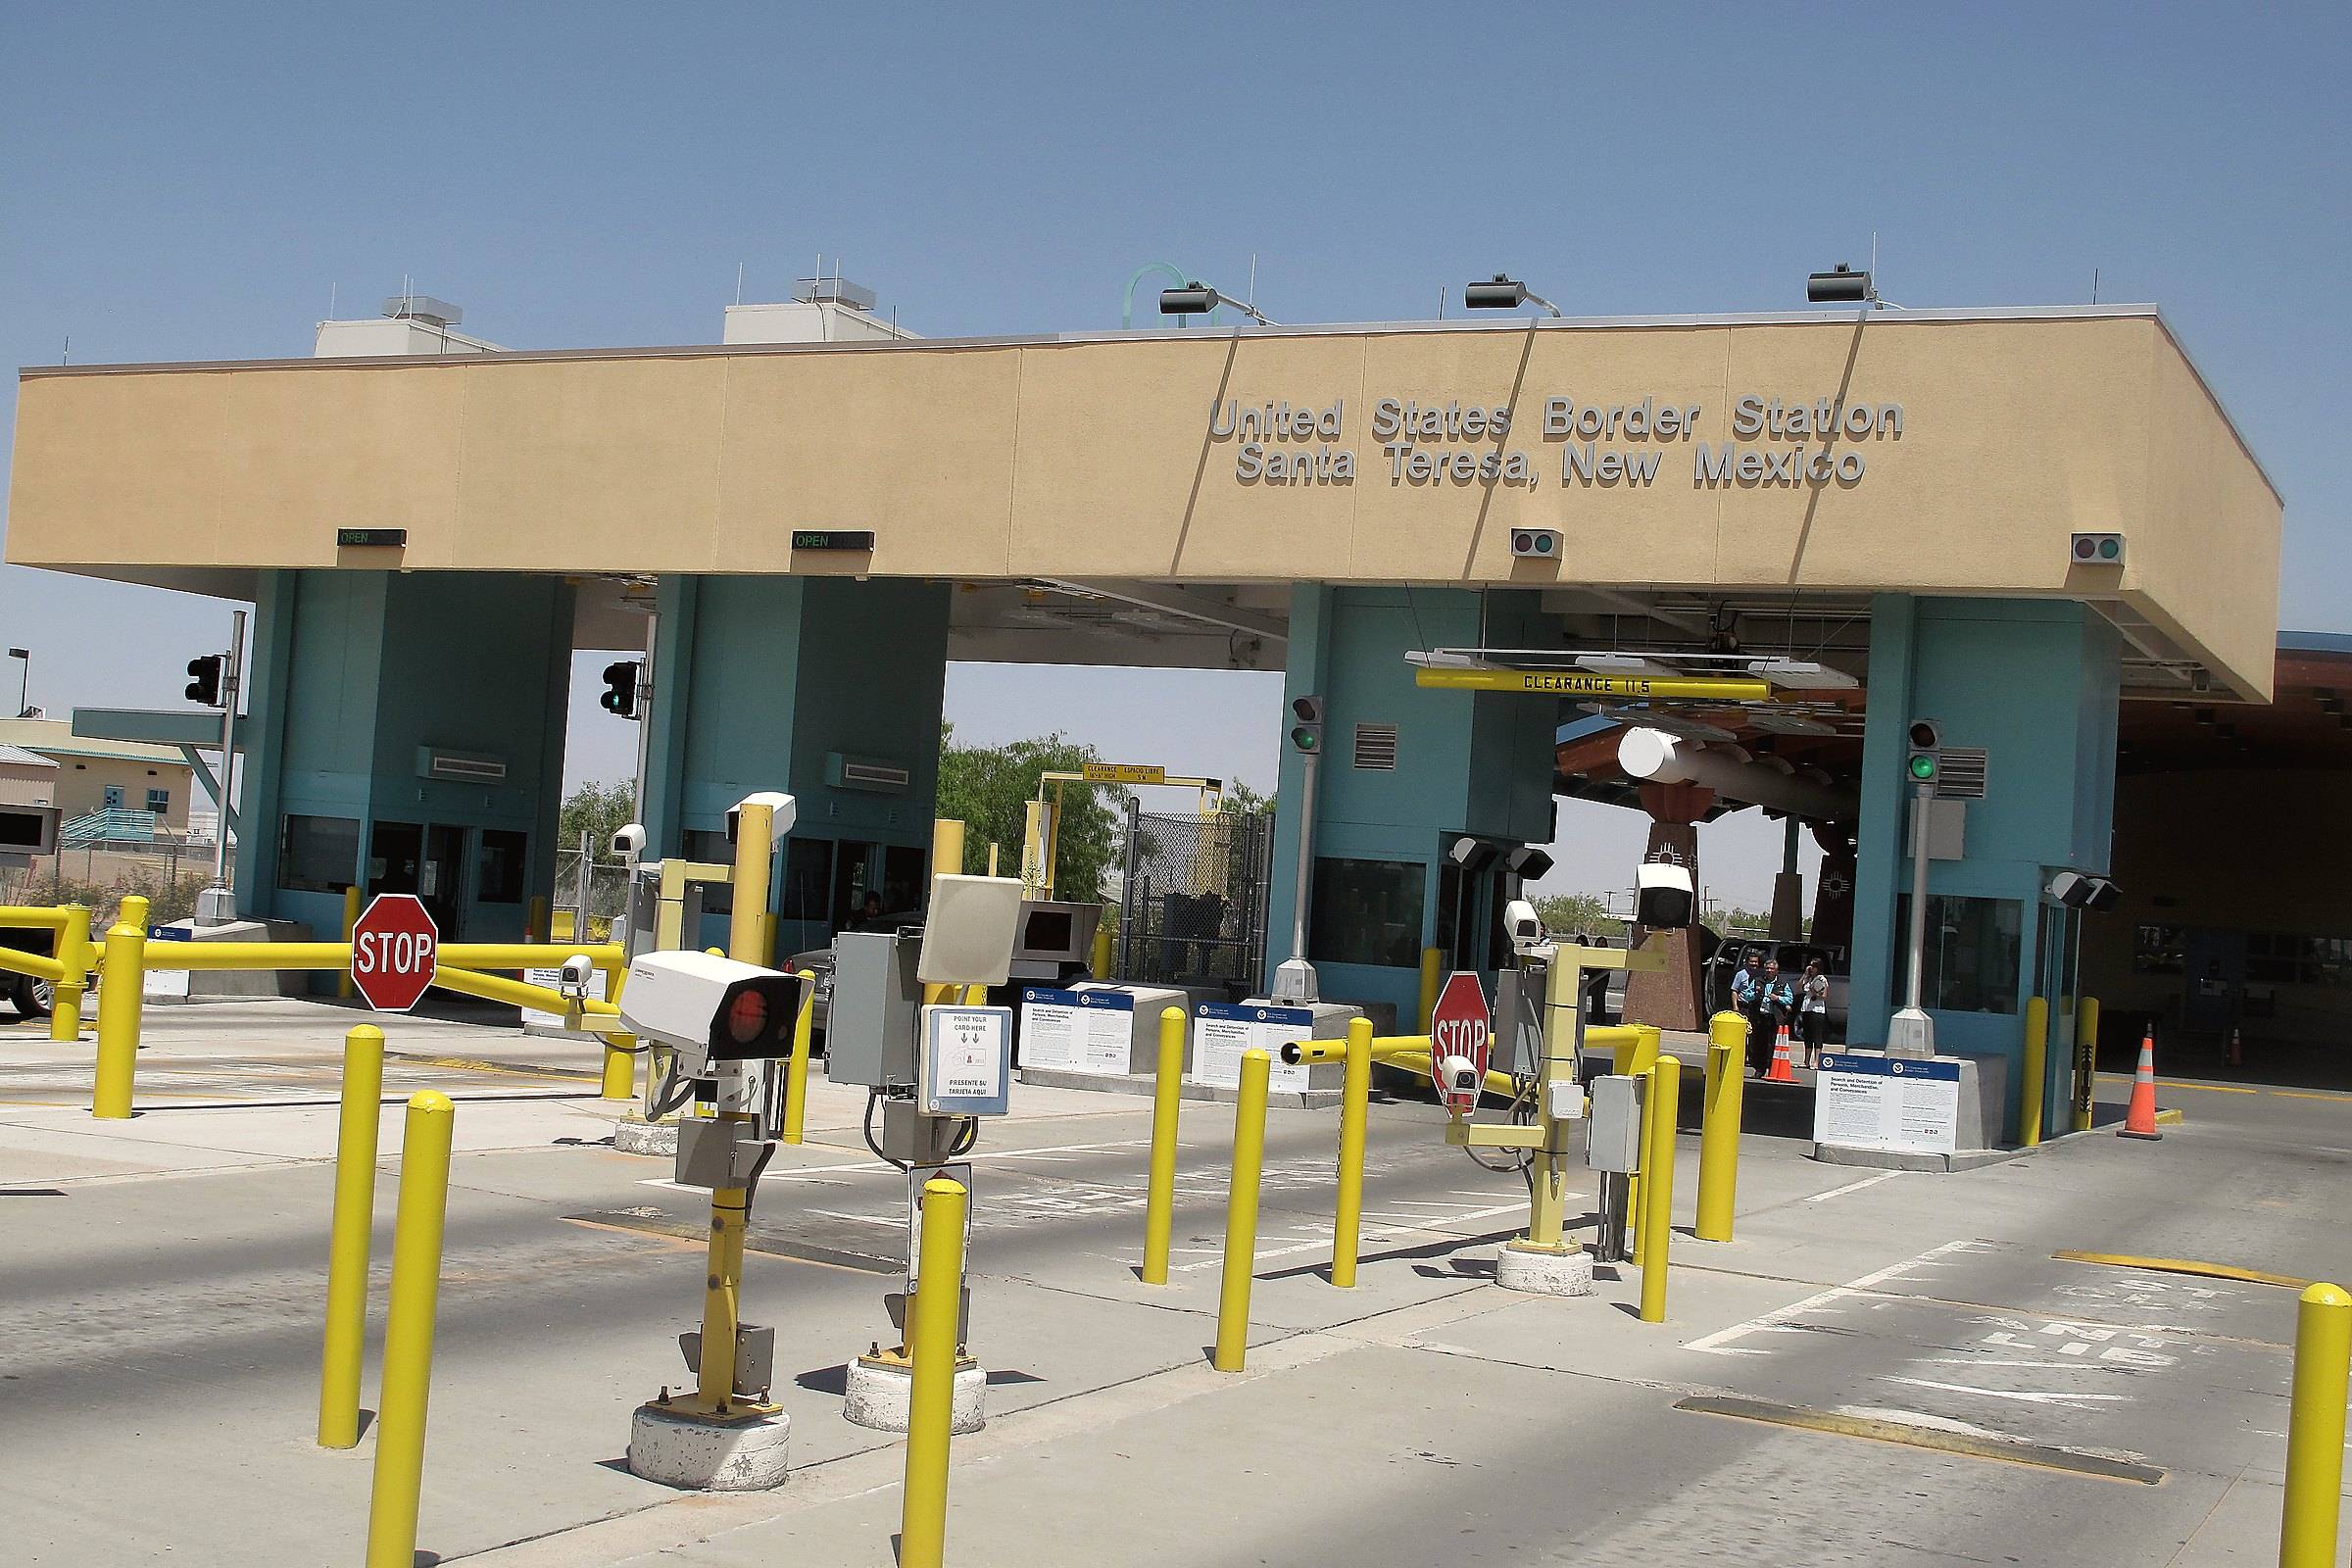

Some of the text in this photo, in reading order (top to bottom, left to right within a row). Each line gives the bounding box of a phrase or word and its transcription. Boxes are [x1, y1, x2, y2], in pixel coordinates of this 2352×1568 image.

[1211, 396, 1903, 438] United States Border Station
[1236, 442, 1866, 486] Santa Teresa, New Mexico
[342, 532, 368, 543] OPEN
[796, 535, 829, 547] OPEN
[1524, 675, 1613, 692] CLEARANCE
[358, 931, 432, 974] STOP
[1437, 1019, 1486, 1071] STOP
